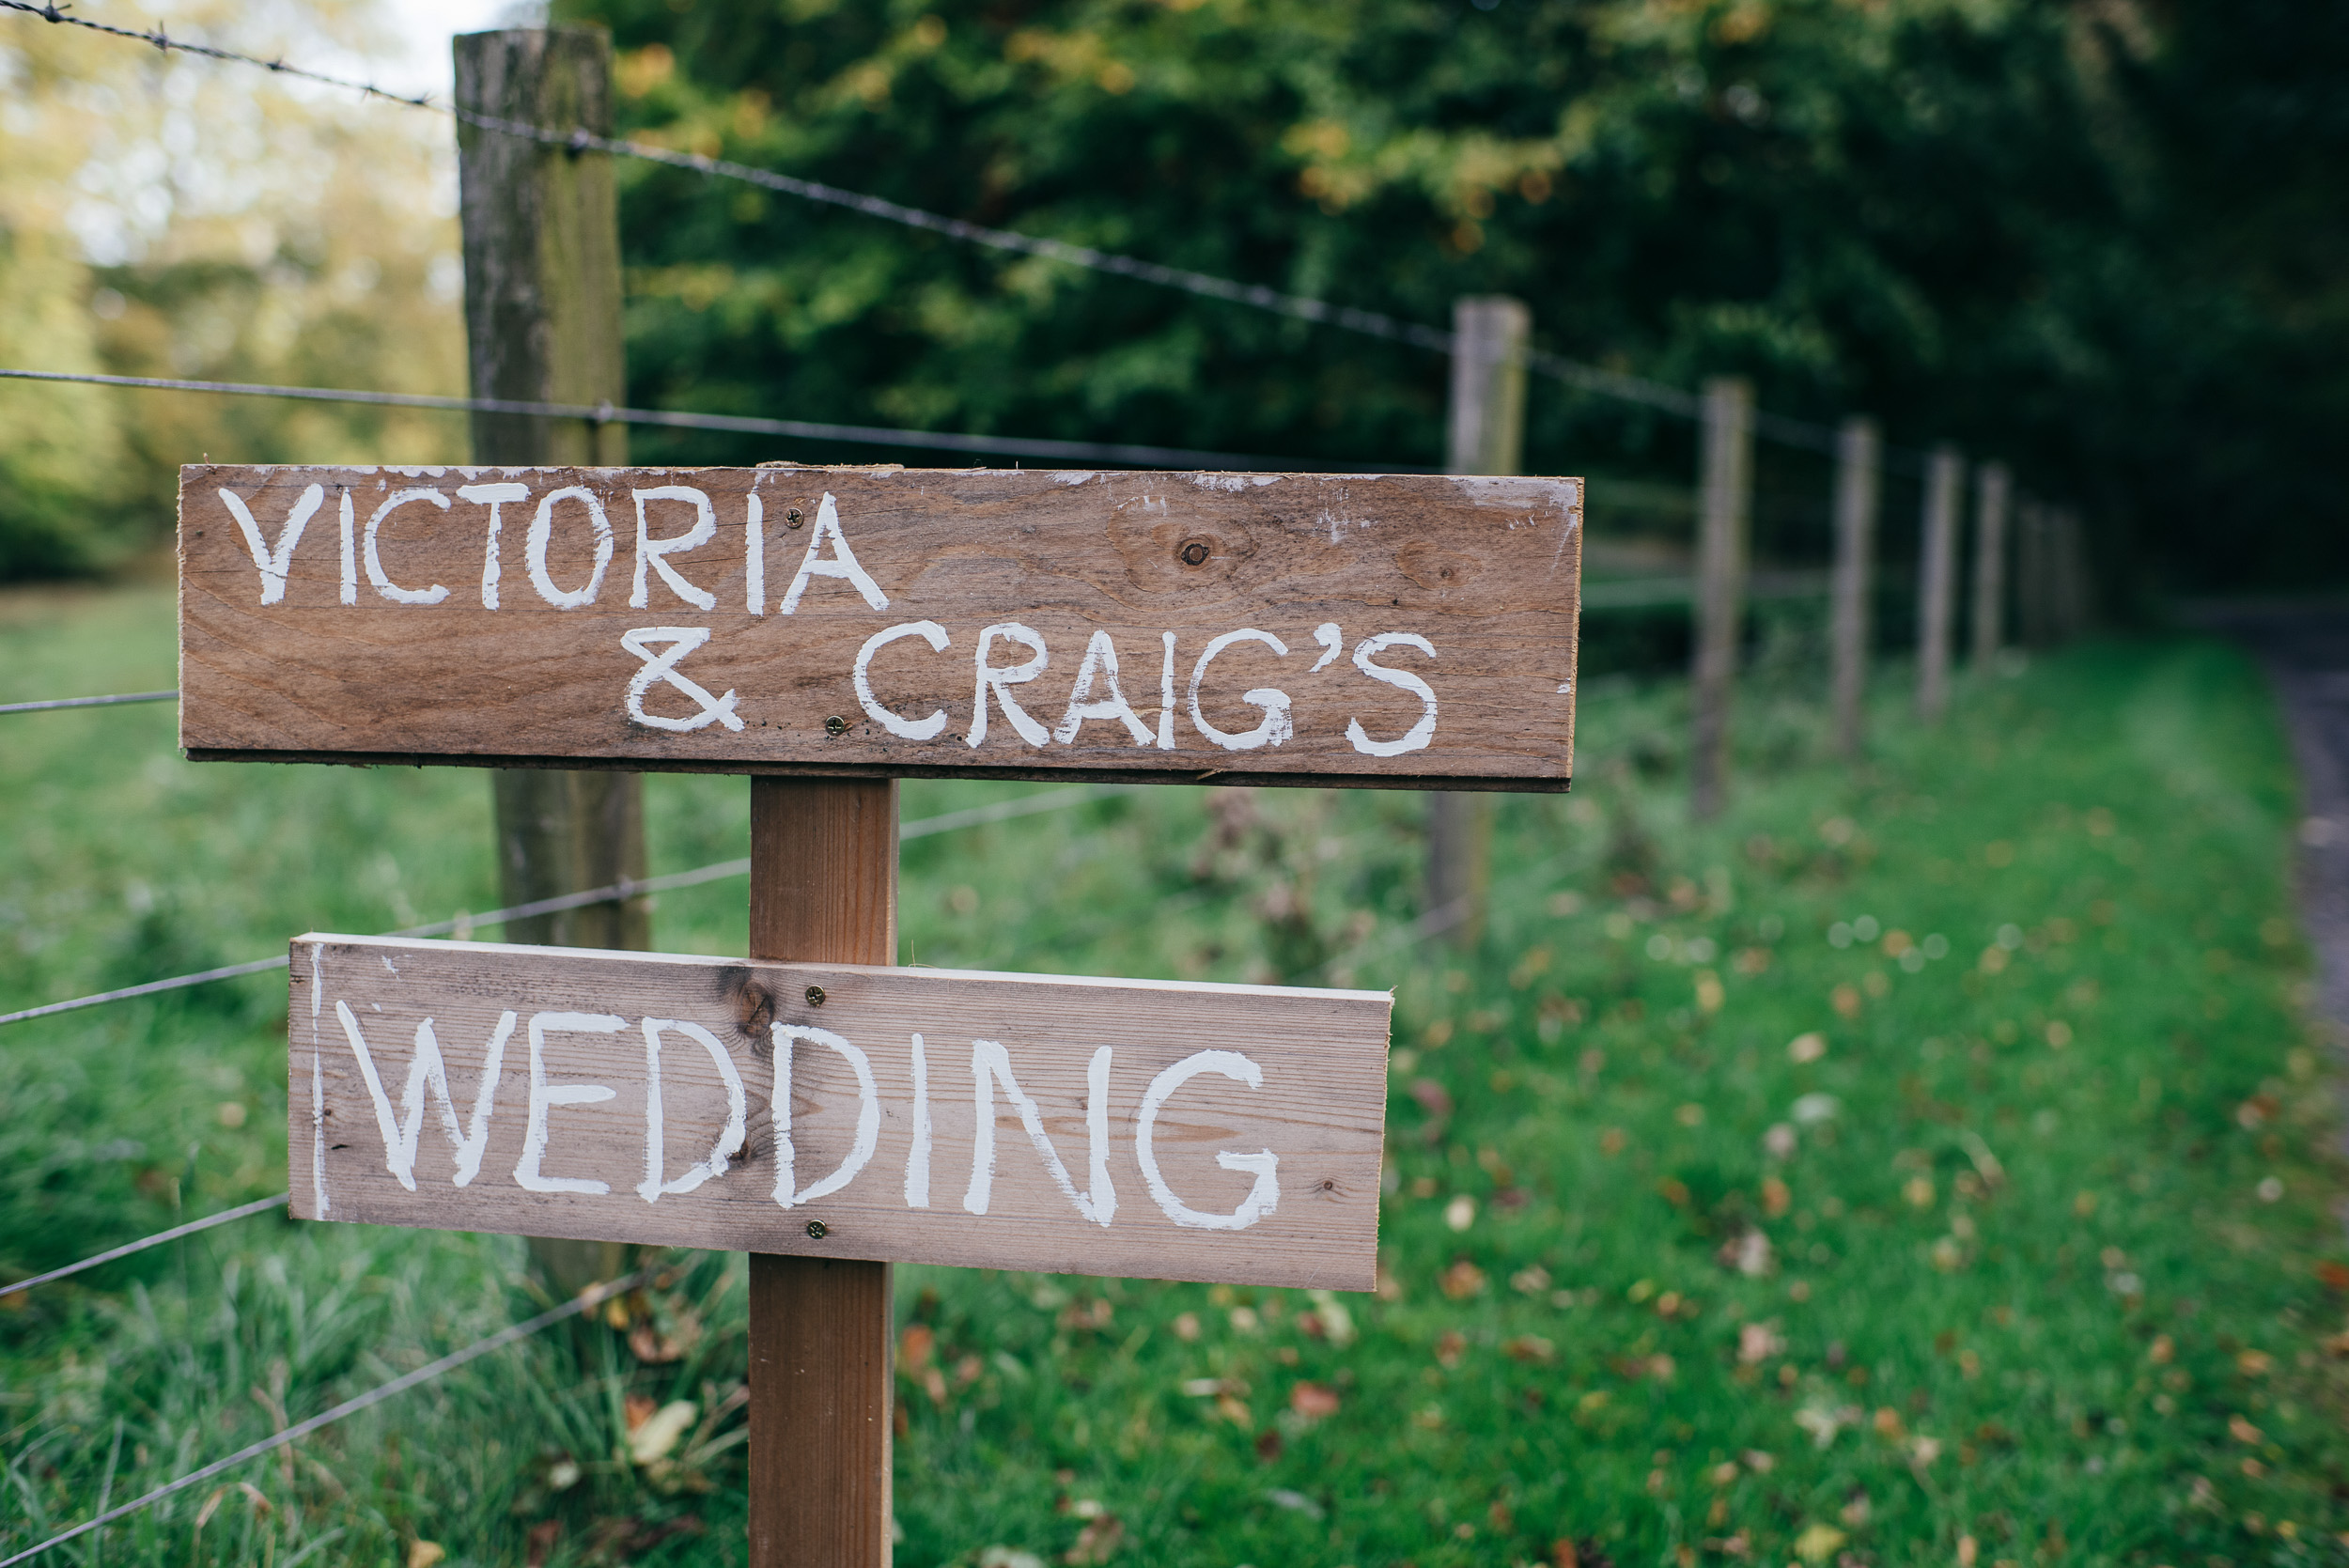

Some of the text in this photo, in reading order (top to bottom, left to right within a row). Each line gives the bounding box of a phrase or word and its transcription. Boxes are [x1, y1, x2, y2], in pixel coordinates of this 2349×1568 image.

[218, 483, 890, 615] VICTORIA
[620, 620, 1439, 757] & CRAIG'S
[334, 999, 1282, 1232] WEDDING
